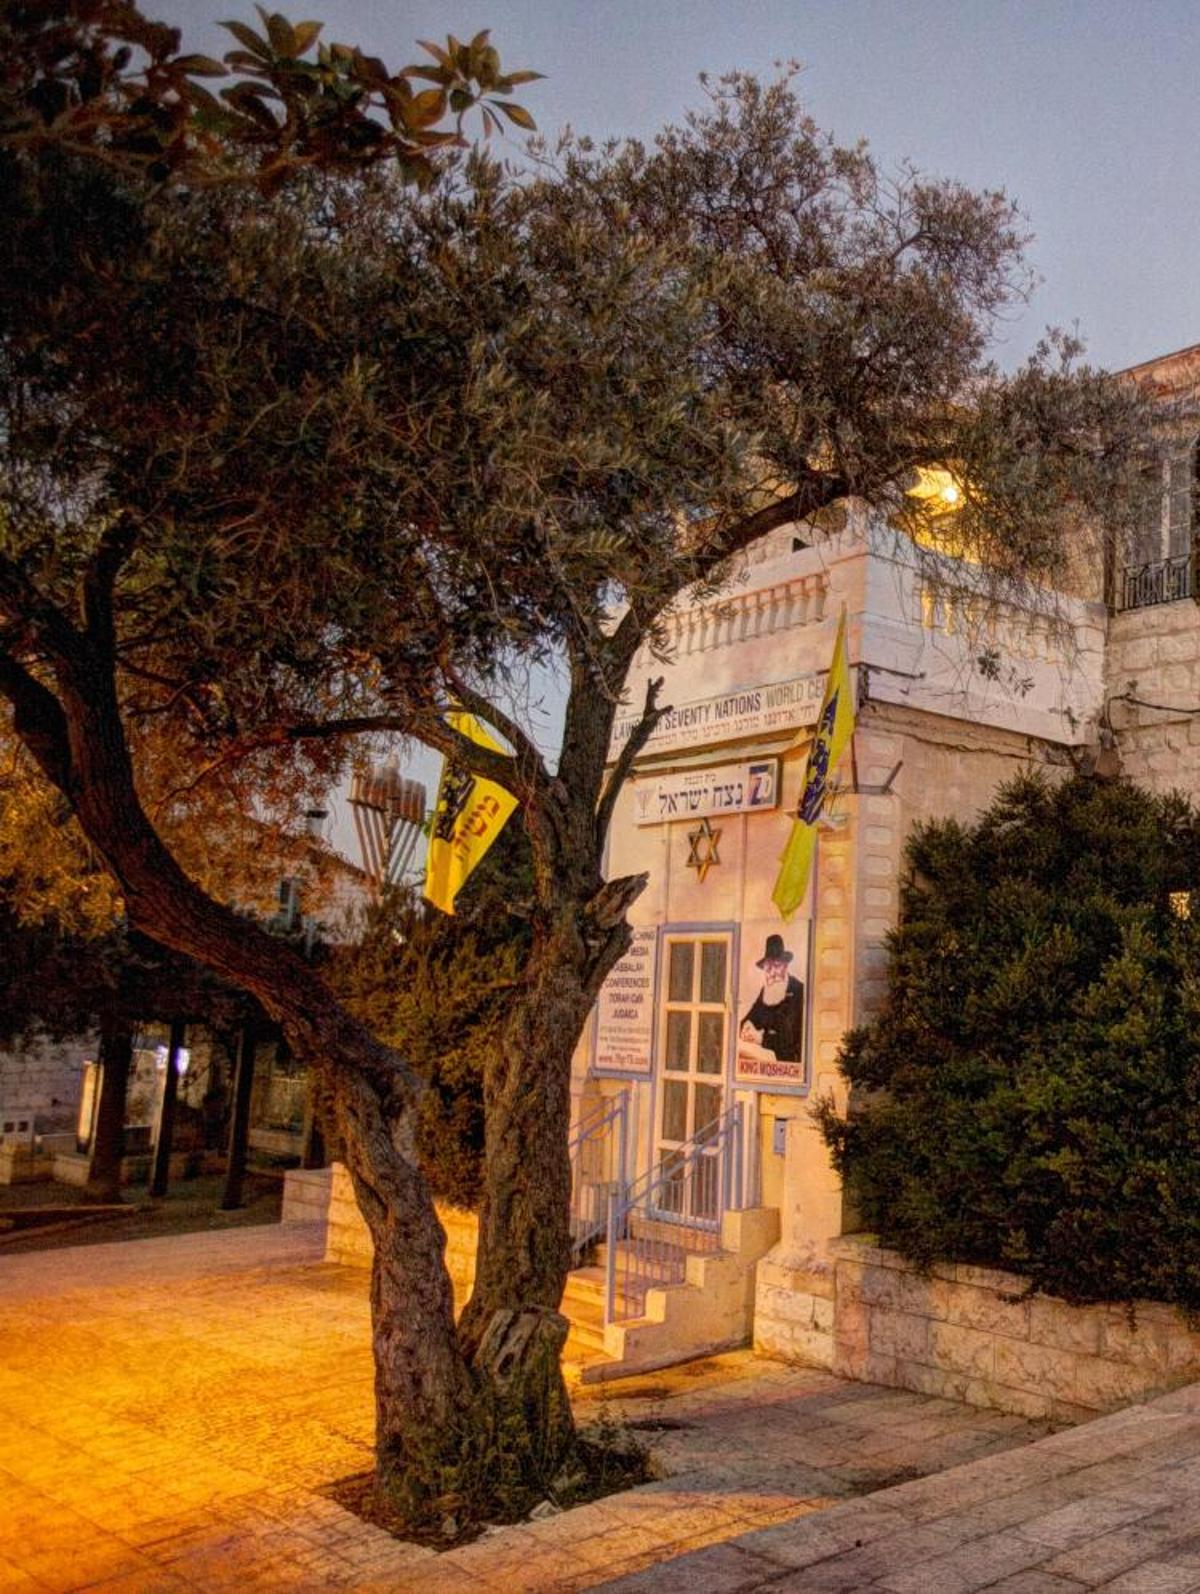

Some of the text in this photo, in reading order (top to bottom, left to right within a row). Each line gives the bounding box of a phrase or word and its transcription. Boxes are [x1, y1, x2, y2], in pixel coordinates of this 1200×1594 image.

[665, 704, 711, 730] SEVENTY
[714, 692, 761, 719] NATIONS
[766, 682, 804, 708] WORLD
[658, 782, 744, 815] נצח ישראל
[740, 1061, 758, 1074] KING
